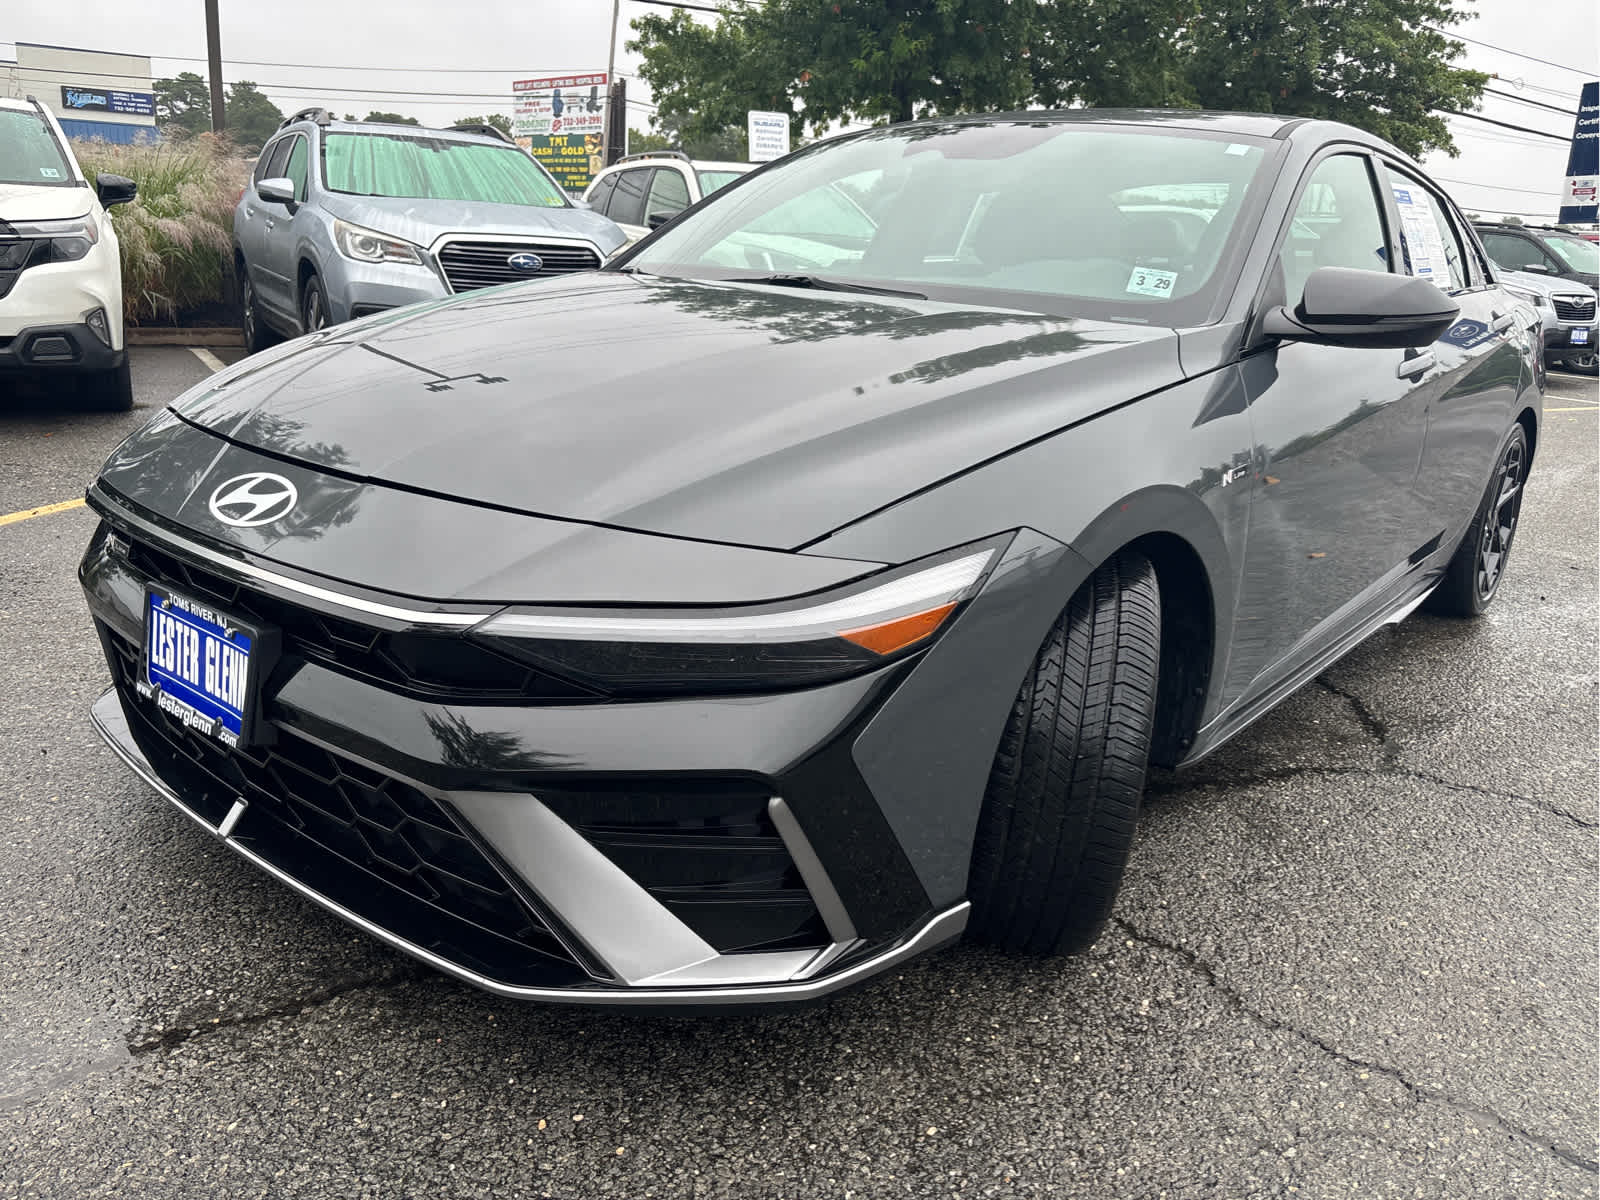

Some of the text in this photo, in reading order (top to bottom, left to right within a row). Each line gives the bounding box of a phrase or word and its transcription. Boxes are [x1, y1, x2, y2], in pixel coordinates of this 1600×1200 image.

[549, 136, 568, 147] TMT
[561, 146, 585, 155] GOLD
[1135, 275, 1171, 290] 3 29
[169, 592, 190, 613] TOMS
[216, 614, 228, 629] NJ
[151, 609, 249, 713] LESTER GLENN
[157, 690, 213, 737] lesterglenn
[218, 730, 237, 749] .com
